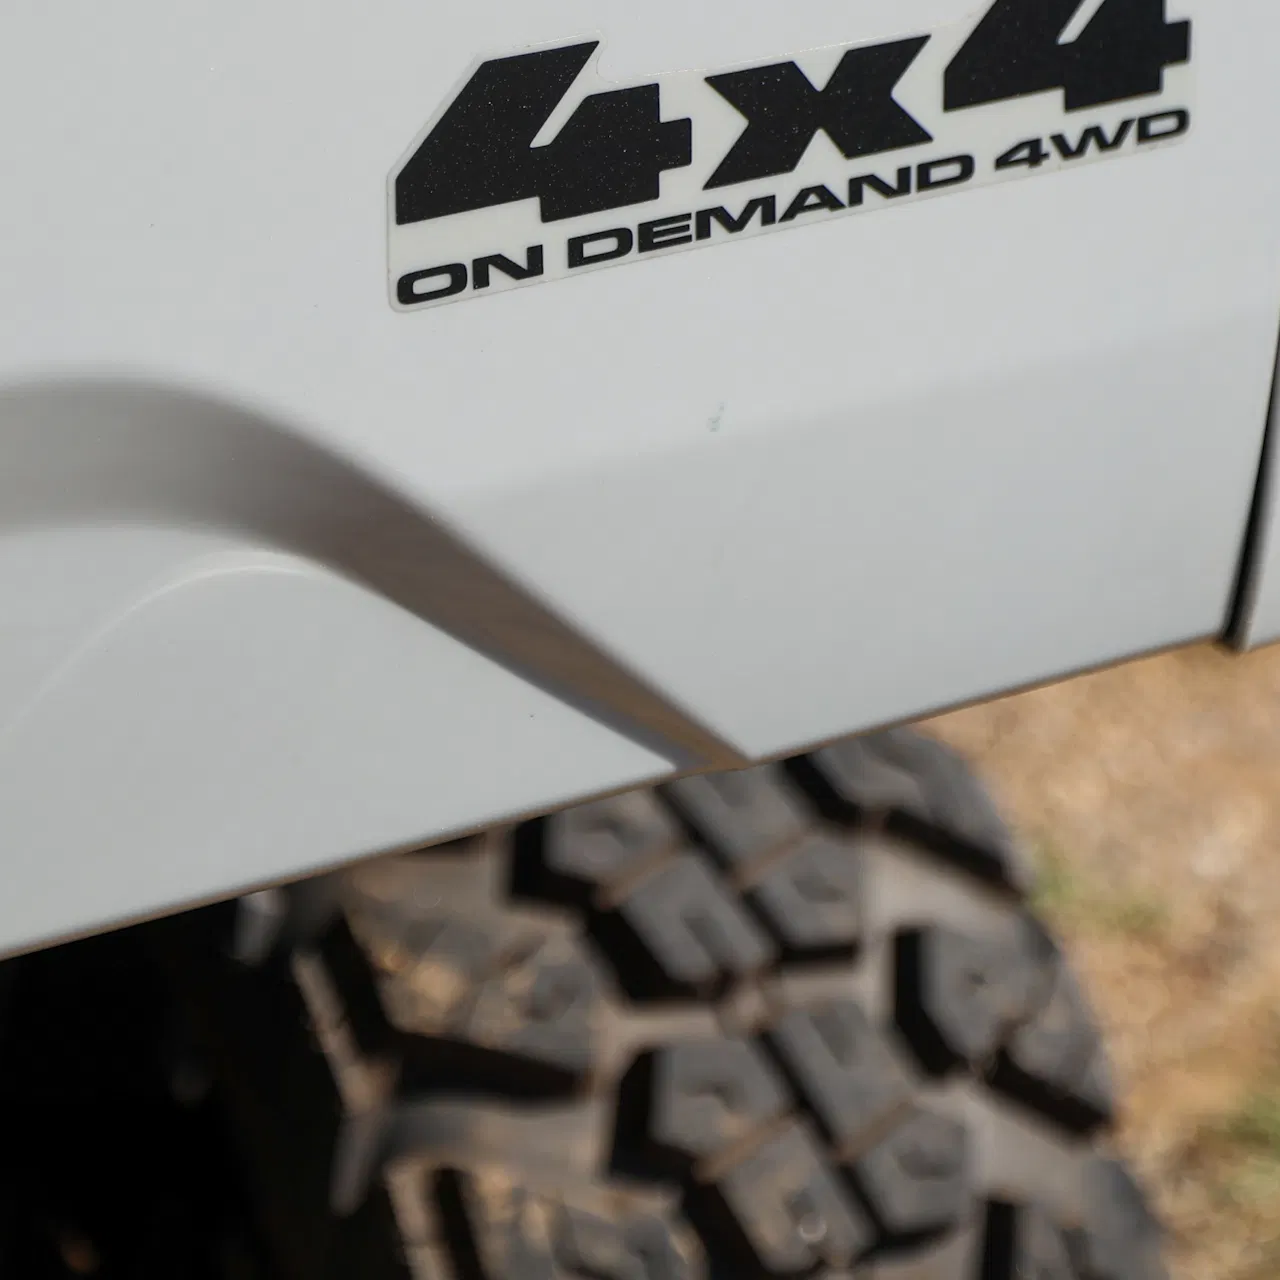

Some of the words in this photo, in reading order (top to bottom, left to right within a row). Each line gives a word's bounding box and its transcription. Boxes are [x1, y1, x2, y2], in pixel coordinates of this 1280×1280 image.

[396, 243, 545, 307] ON
[567, 153, 976, 270] DEMAND
[993, 108, 1191, 171] 4WD
